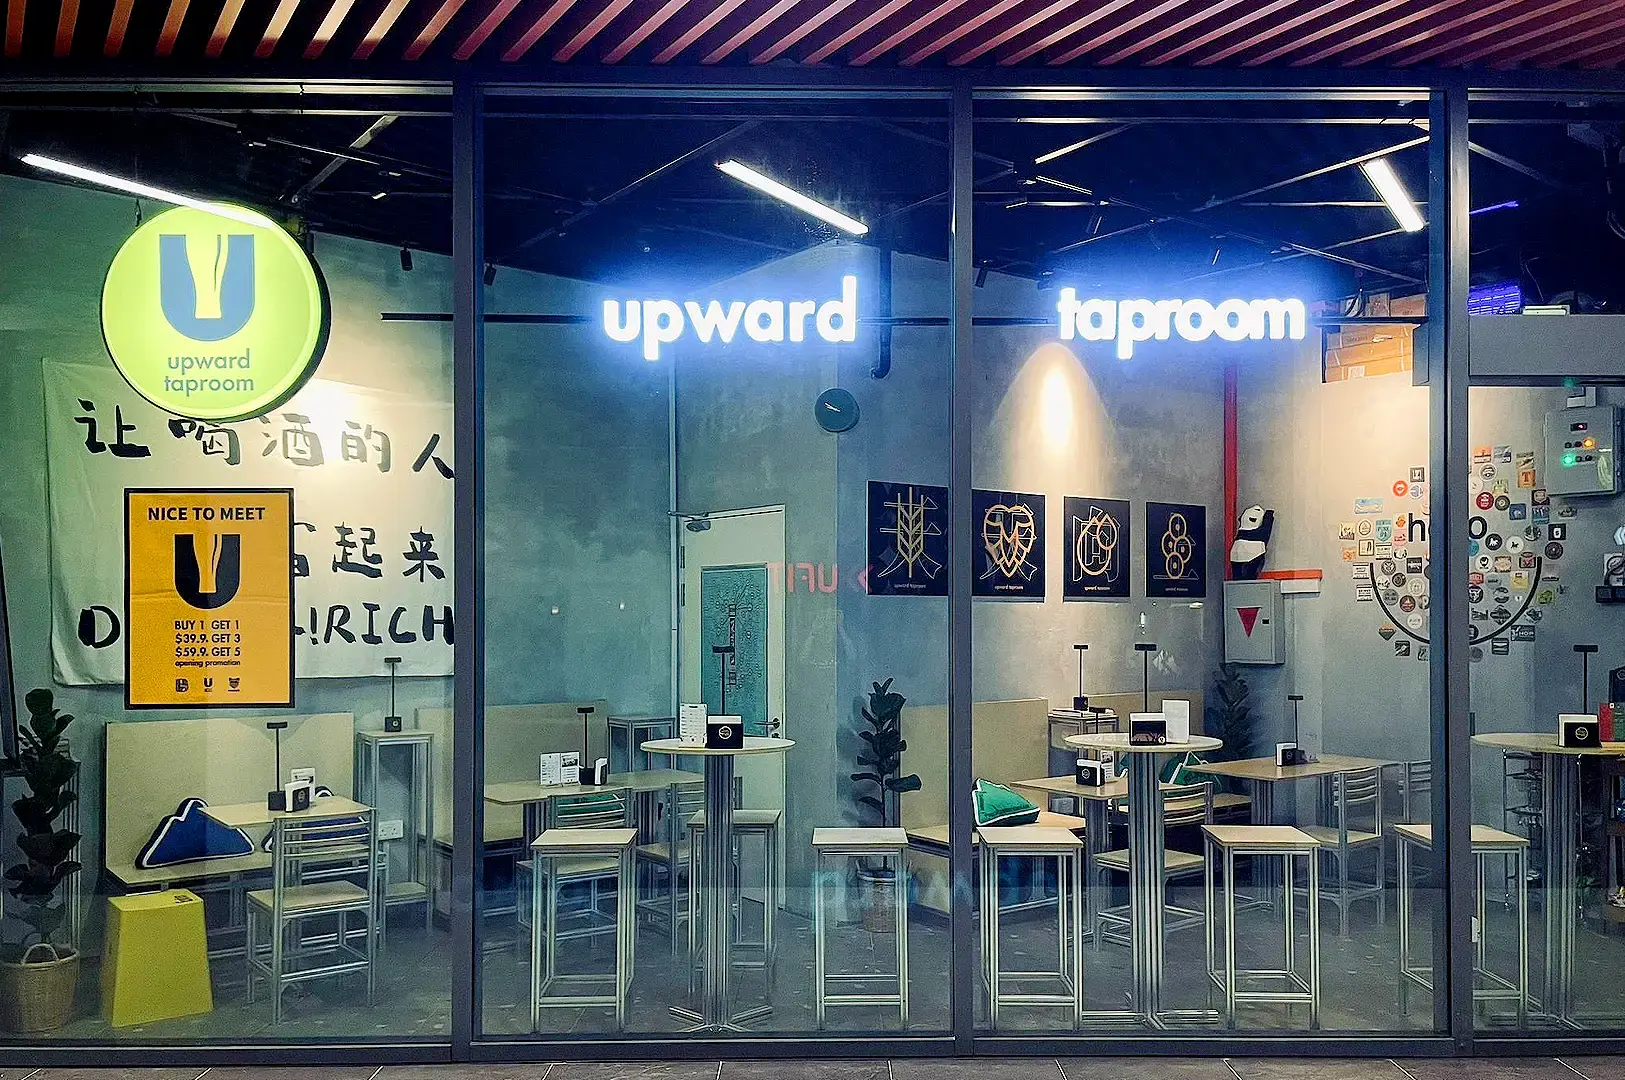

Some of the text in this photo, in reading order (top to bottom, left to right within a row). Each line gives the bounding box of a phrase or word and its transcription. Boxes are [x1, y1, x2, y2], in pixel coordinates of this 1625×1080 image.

[602, 275, 858, 361] upward
[1057, 287, 1306, 360] taproom
[167, 347, 250, 376] upward
[163, 375, 255, 397] taproom
[148, 507, 266, 521] NICE TO MEET
[174, 620, 240, 630] BUY 1 GET 1
[211, 633, 231, 643] GET
[233, 633, 241, 643] 3
[211, 646, 231, 657] GET
[233, 646, 241, 657] 5
[174, 659, 241, 668] opening promotion
